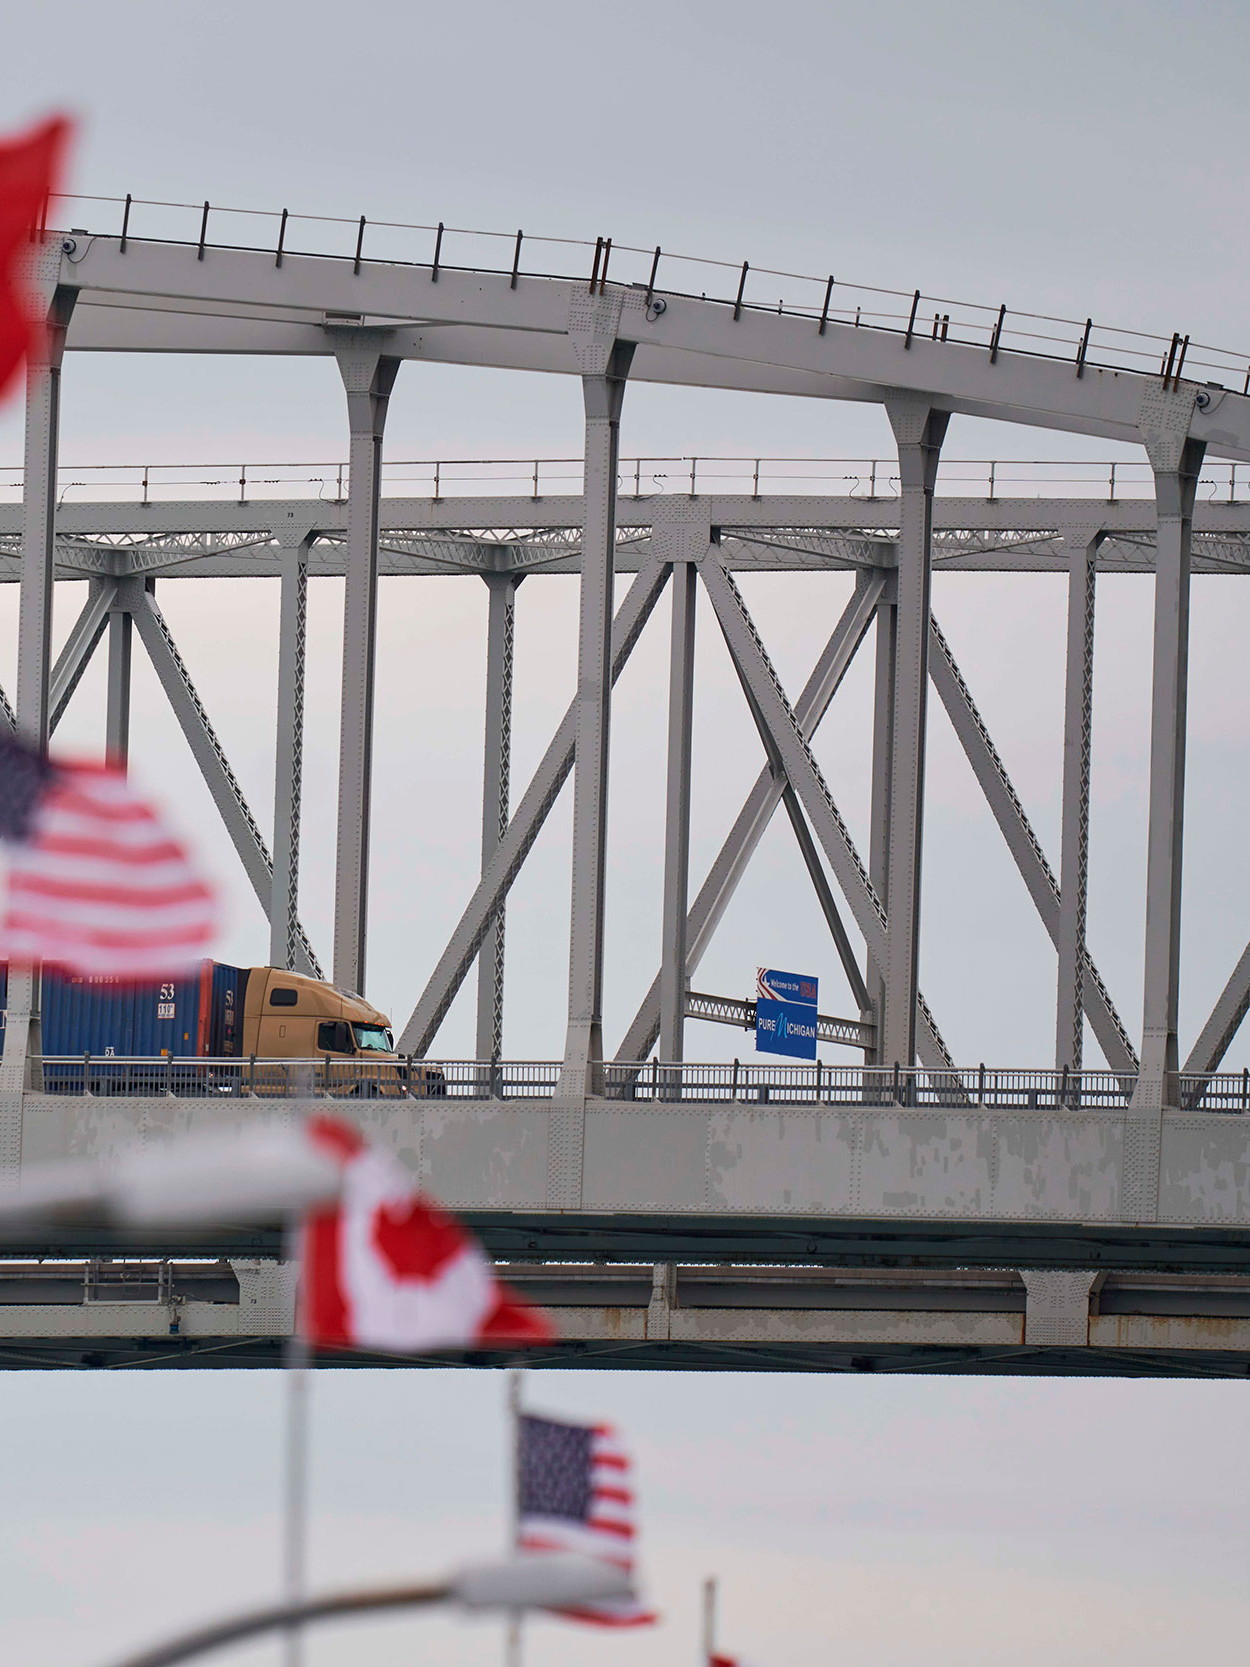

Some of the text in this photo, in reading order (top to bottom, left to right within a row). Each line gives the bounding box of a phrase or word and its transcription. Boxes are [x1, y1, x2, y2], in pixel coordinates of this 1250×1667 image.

[159, 983, 175, 1000] 53
[770, 979, 787, 989] Welcome
[800, 982, 816, 998] USA
[758, 1018, 776, 1031] PURE
